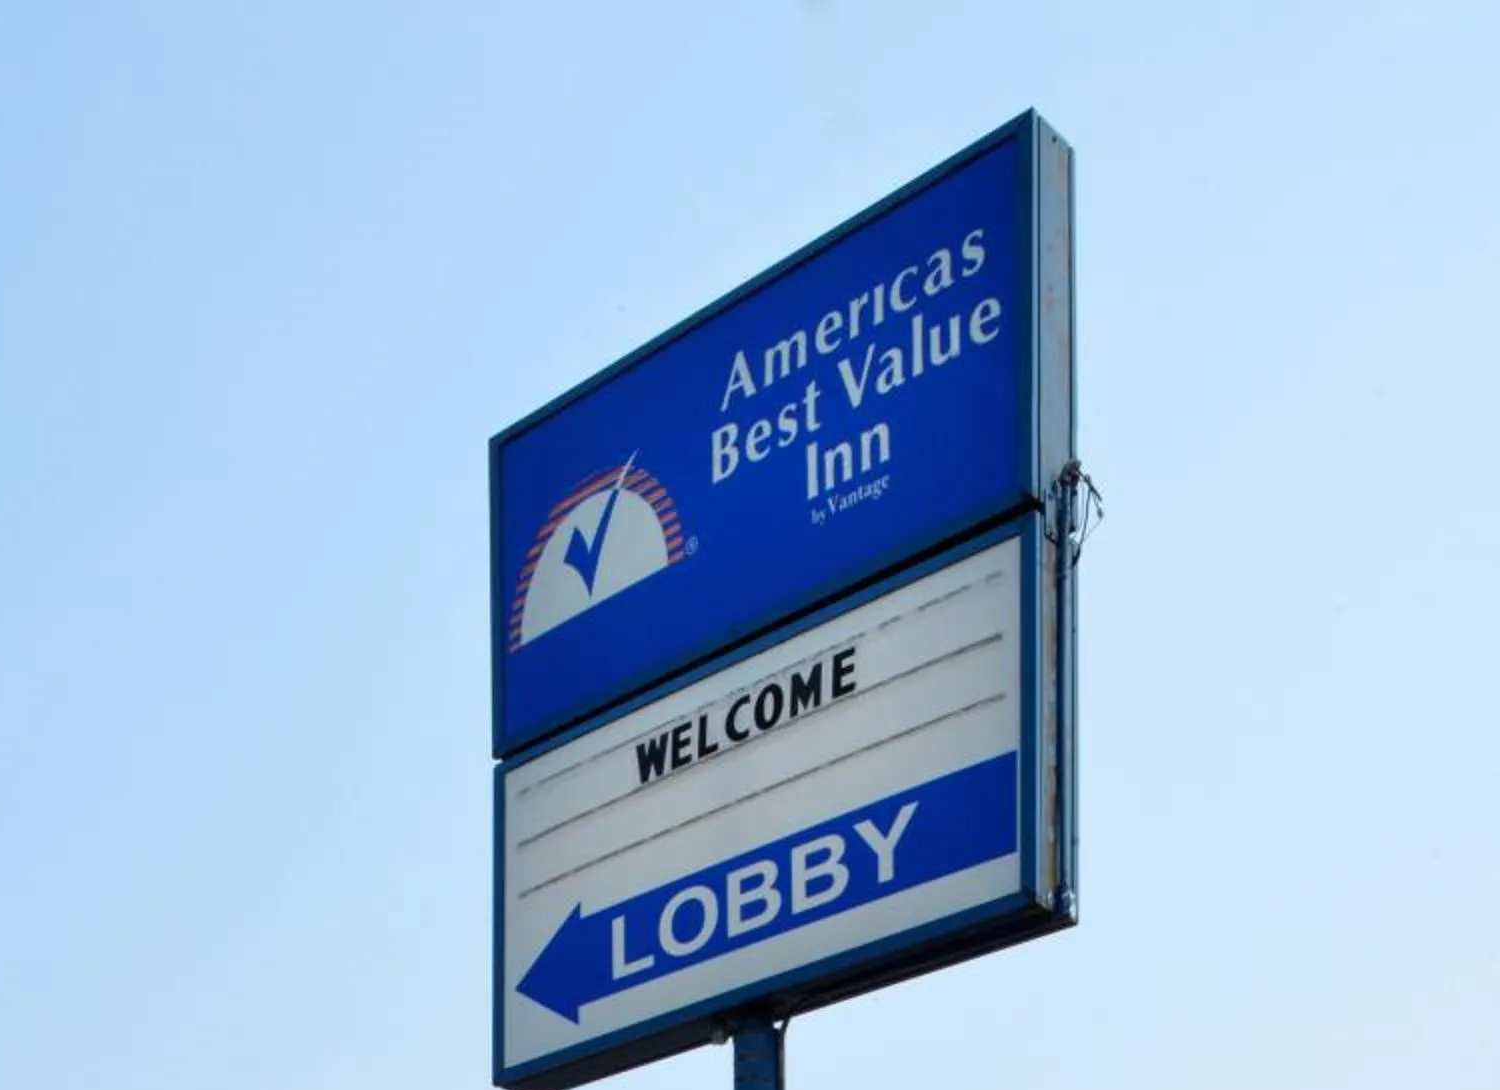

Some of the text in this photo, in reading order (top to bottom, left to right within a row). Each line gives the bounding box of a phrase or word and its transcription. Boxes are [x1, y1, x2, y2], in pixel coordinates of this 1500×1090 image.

[710, 296, 1003, 485] Best Value
[720, 228, 986, 412] Americas
[806, 422, 891, 500] Inn
[811, 474, 891, 526] by Vantage
[636, 647, 857, 784] WELCOME
[611, 802, 920, 980] LOBBY
